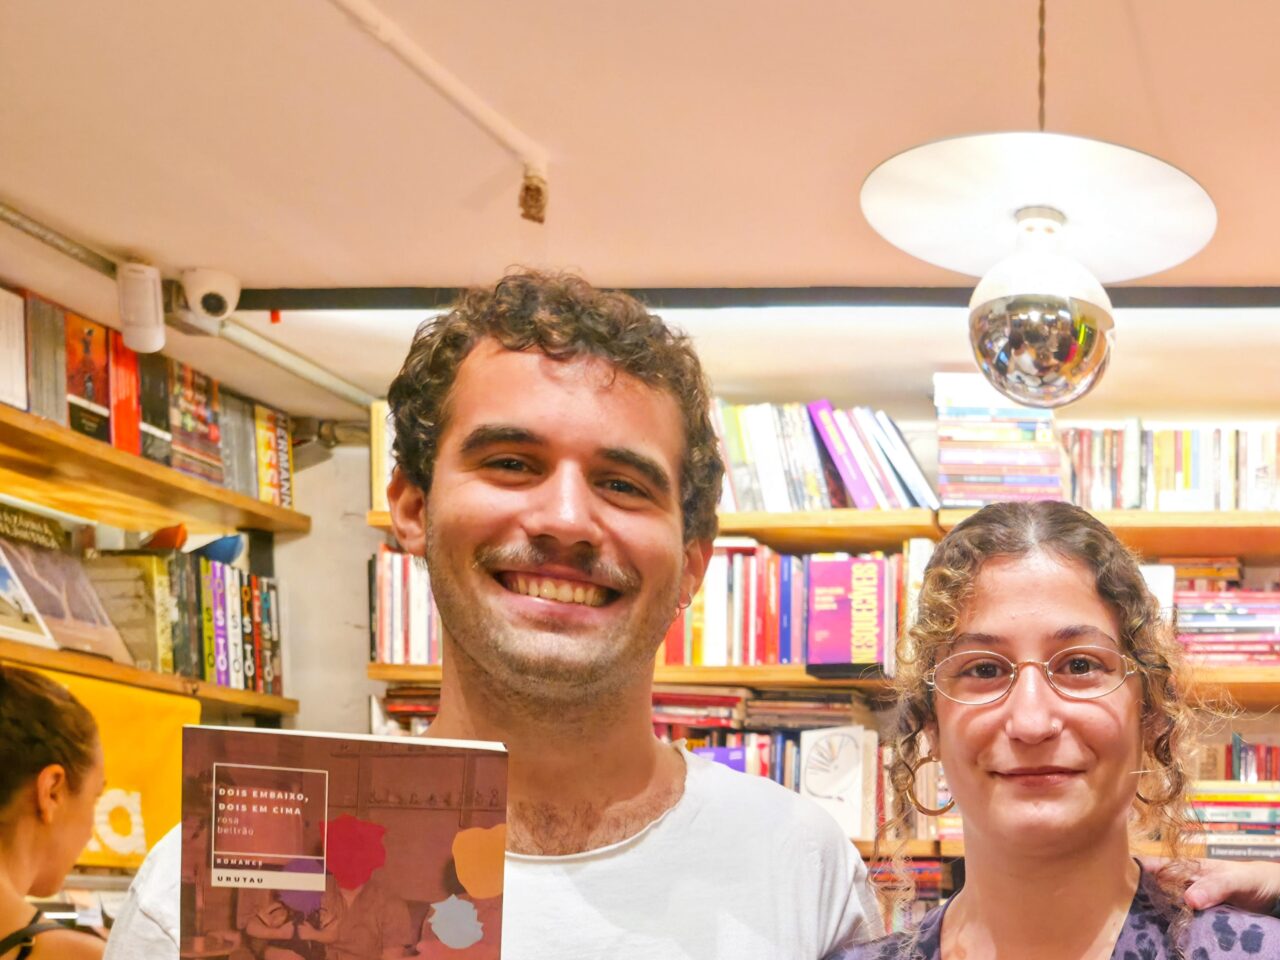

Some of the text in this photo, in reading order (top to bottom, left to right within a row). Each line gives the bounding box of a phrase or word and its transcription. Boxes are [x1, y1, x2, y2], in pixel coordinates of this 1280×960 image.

[219, 788, 309, 803] DOIS EMBAIXO,
[218, 803, 302, 815] DOIS EM CIMA
[217, 876, 263, 884] URUTAU
